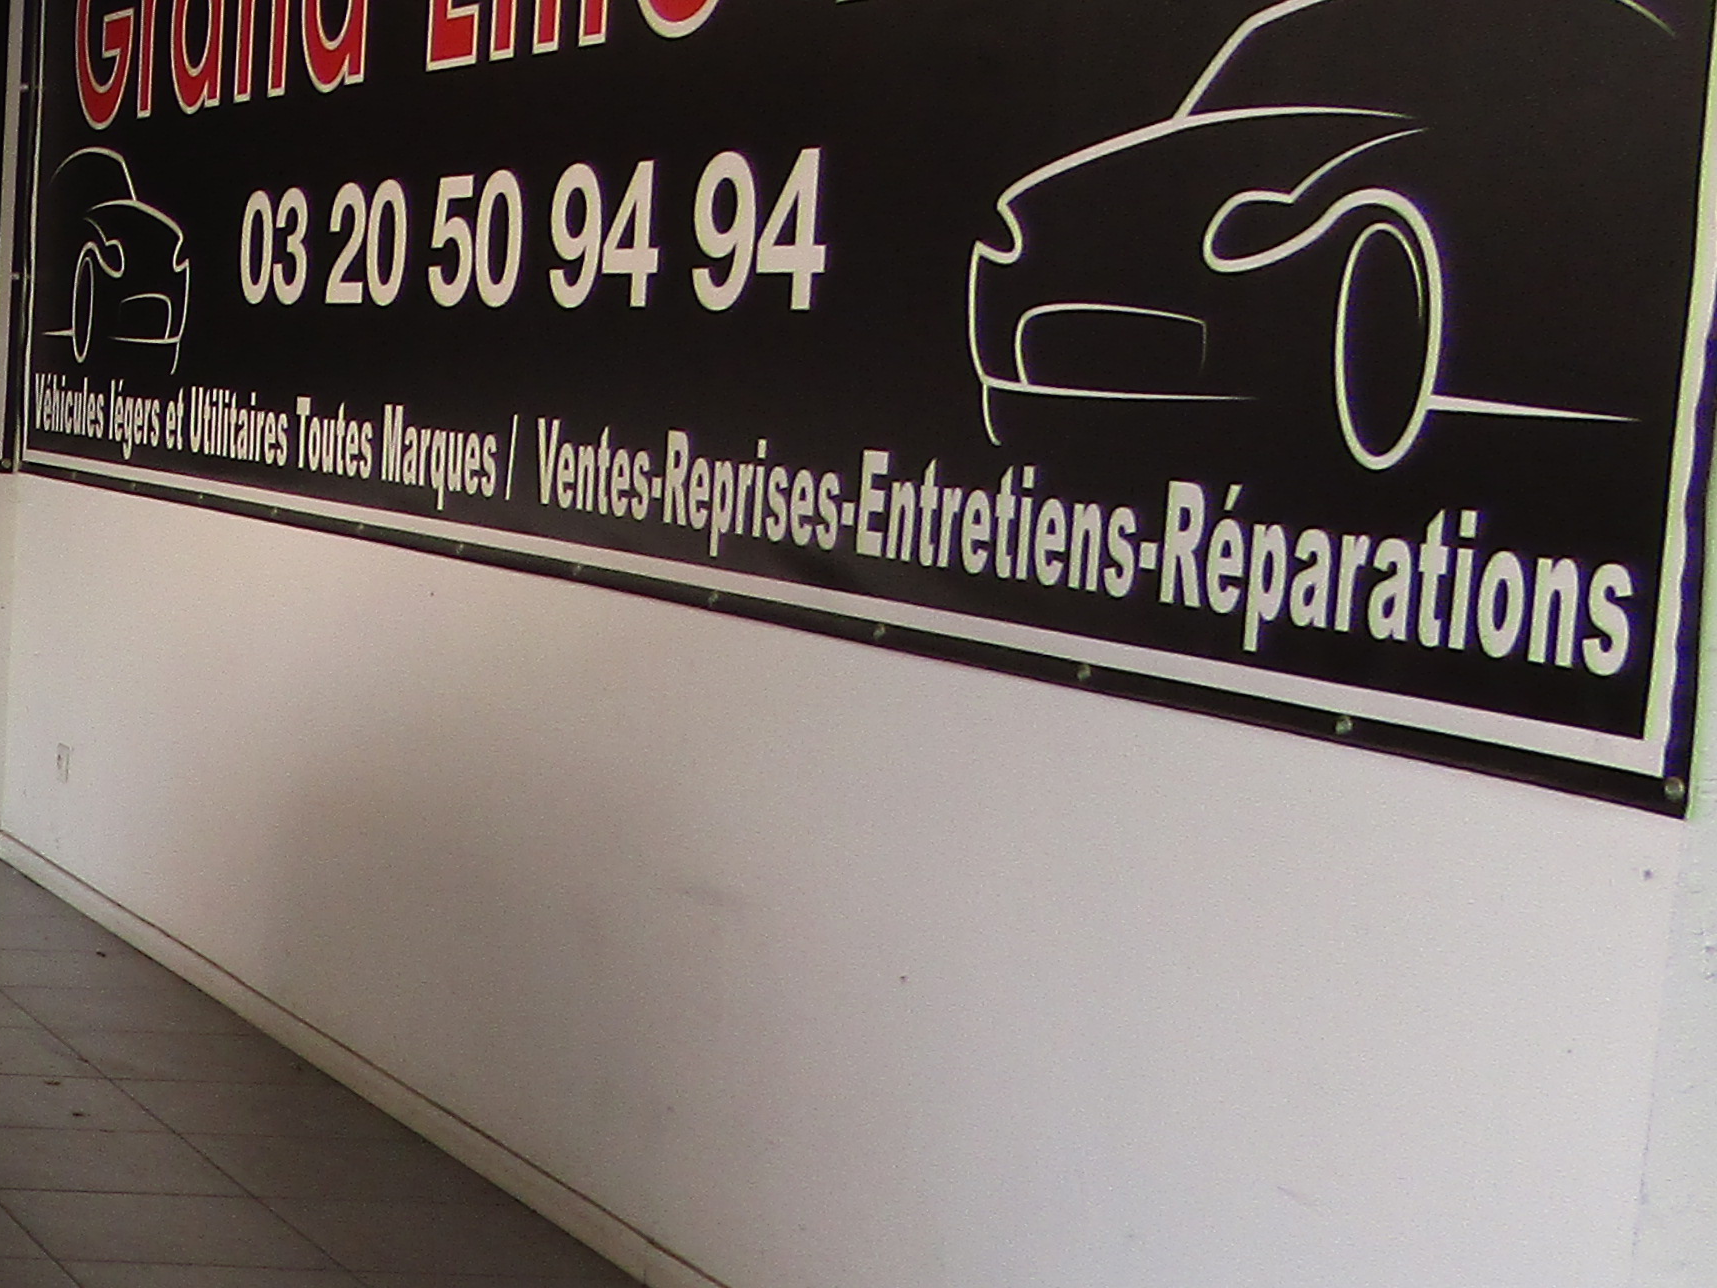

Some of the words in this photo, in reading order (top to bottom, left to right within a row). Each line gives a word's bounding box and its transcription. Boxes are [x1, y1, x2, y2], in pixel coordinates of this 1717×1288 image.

[241, 188, 309, 304] 03
[326, 179, 407, 307] 20
[428, 170, 522, 308] 50
[549, 161, 659, 308] 94
[692, 148, 826, 311] 94
[35, 373, 105, 440] Véhicules
[108, 378, 160, 460] légers
[166, 386, 184, 451] et
[191, 385, 288, 467] Utilitaires
[296, 396, 373, 479] Toutes
[381, 404, 497, 511] Marques
